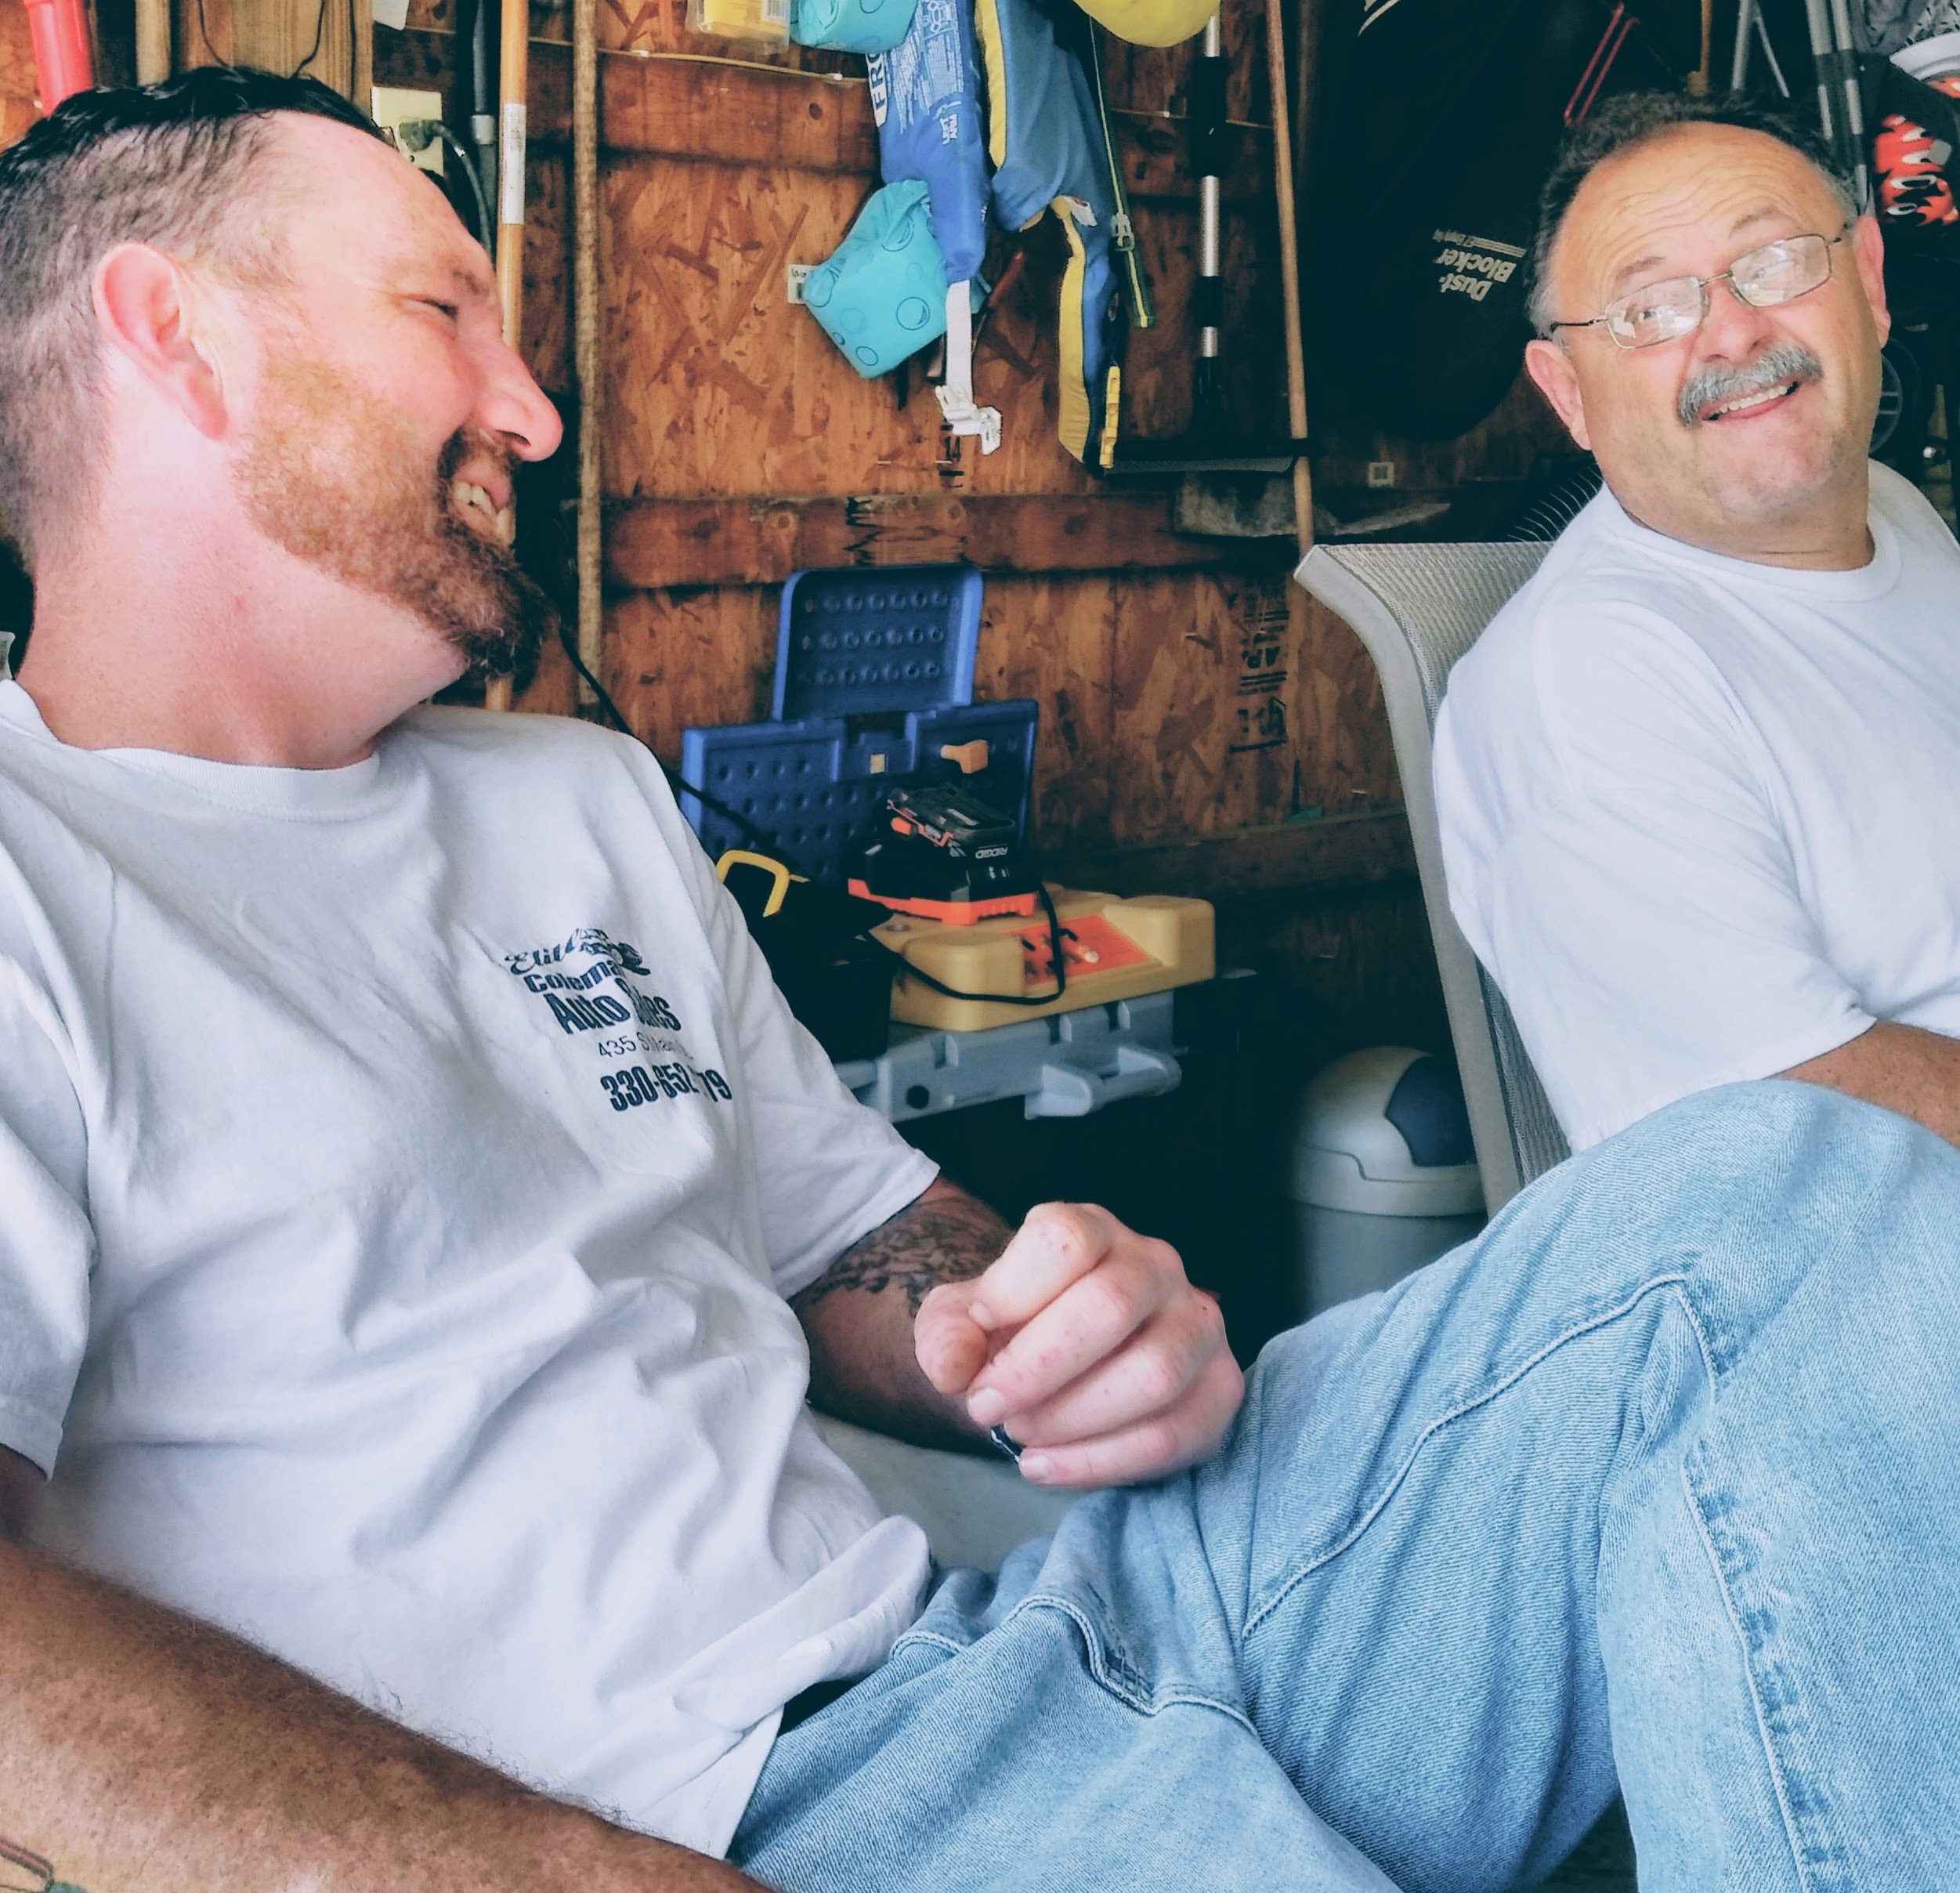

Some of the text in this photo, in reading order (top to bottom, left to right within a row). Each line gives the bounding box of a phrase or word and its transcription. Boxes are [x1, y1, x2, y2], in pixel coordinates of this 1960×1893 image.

[1434, 248, 1517, 283] Blocker
[543, 993, 631, 1035] Auto
[598, 1035, 637, 1059] 435
